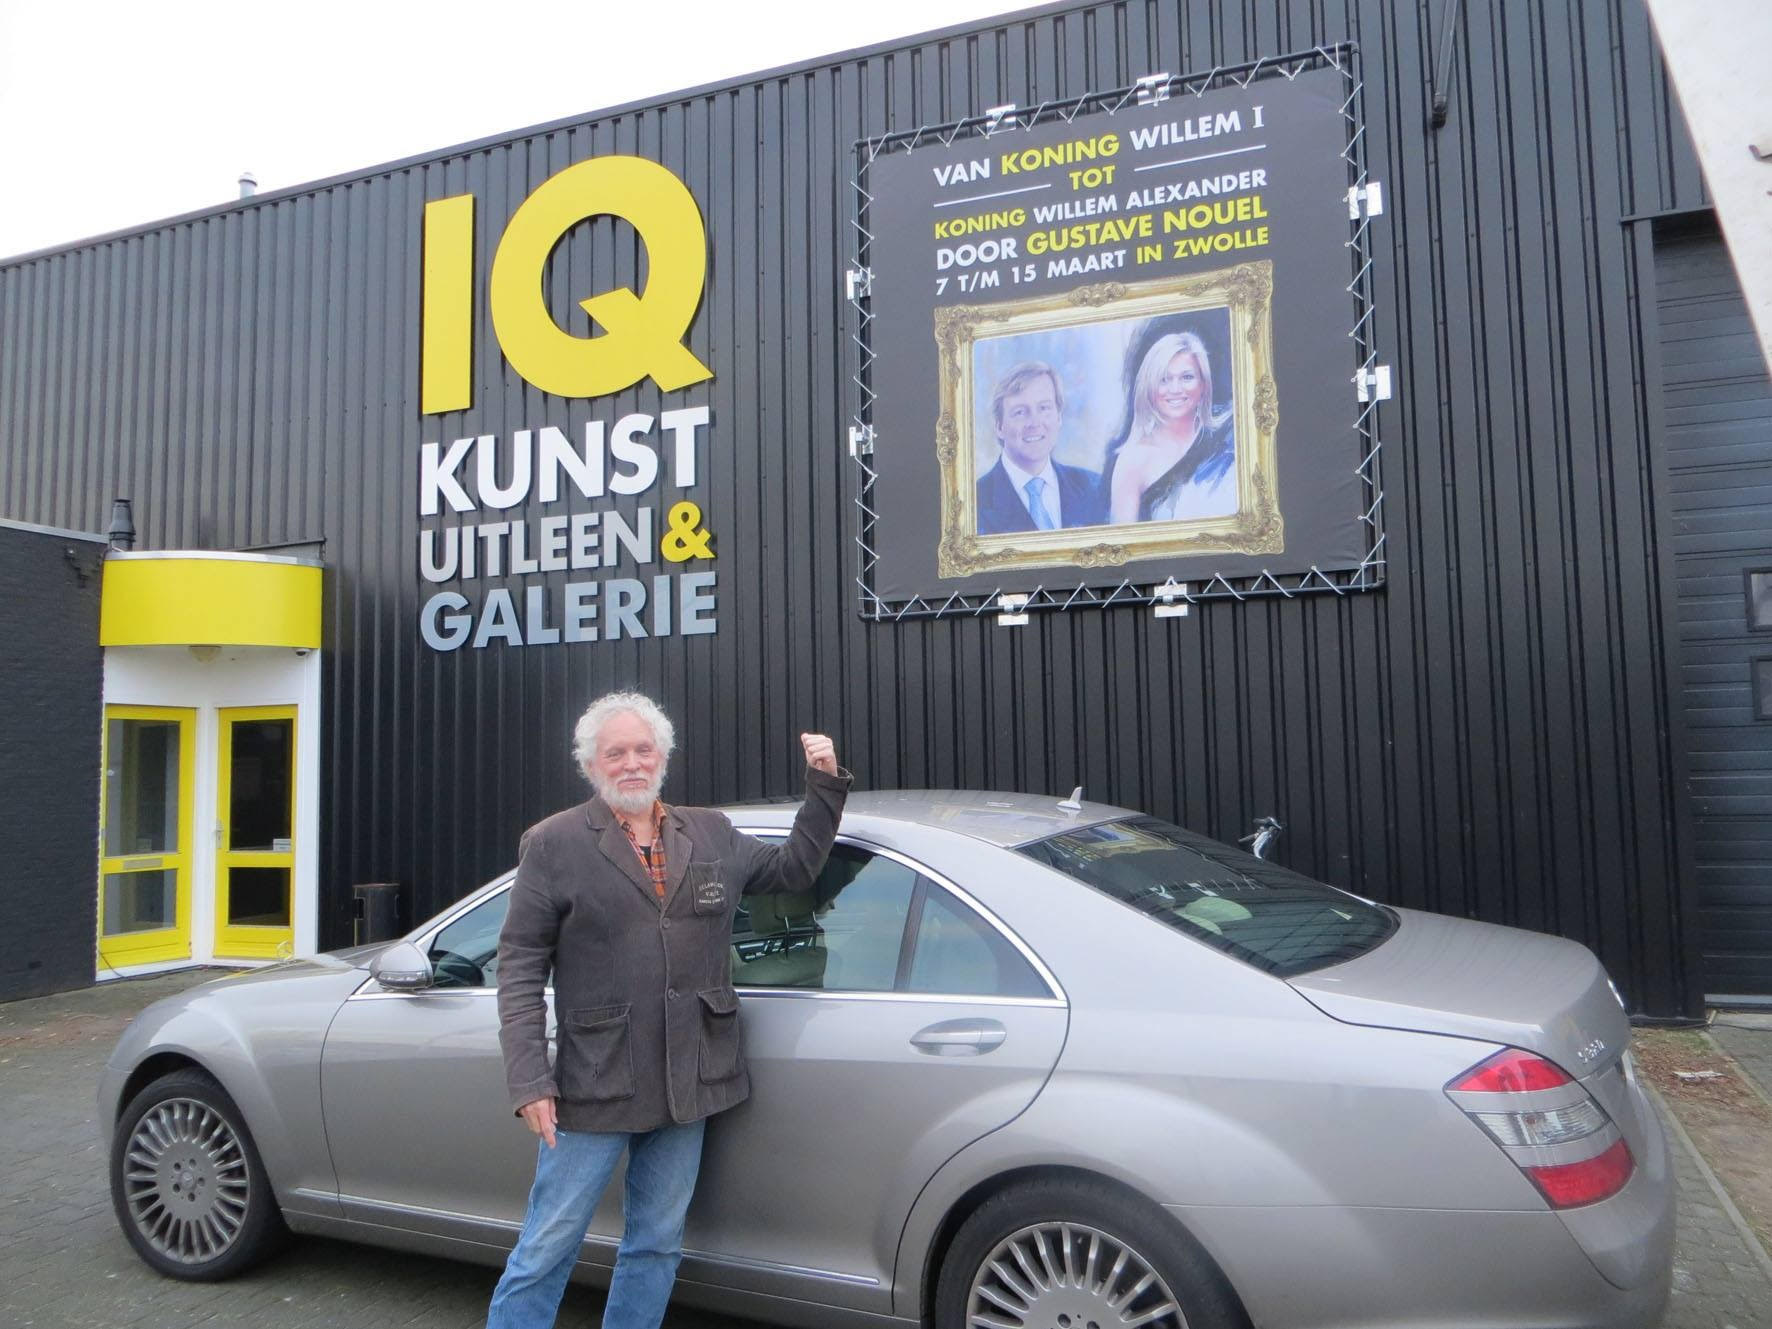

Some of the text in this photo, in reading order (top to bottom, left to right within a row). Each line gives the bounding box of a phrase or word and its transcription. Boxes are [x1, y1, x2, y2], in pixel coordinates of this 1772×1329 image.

[933, 104, 1265, 187] VAN KONING WILLEM I
[1068, 165, 1116, 191] TOT
[934, 168, 1268, 240] KONING WILLEM ALEXANDER
[936, 195, 1268, 271] DOOR GUSTAVE NOUEL
[422, 155, 714, 414] IQ
[936, 226, 1270, 296] 7 T/M 15 MAART IN ZWOLLE
[420, 406, 710, 516] KUNST
[420, 501, 716, 583] UITLEEN &
[420, 571, 717, 652] GALERIE
